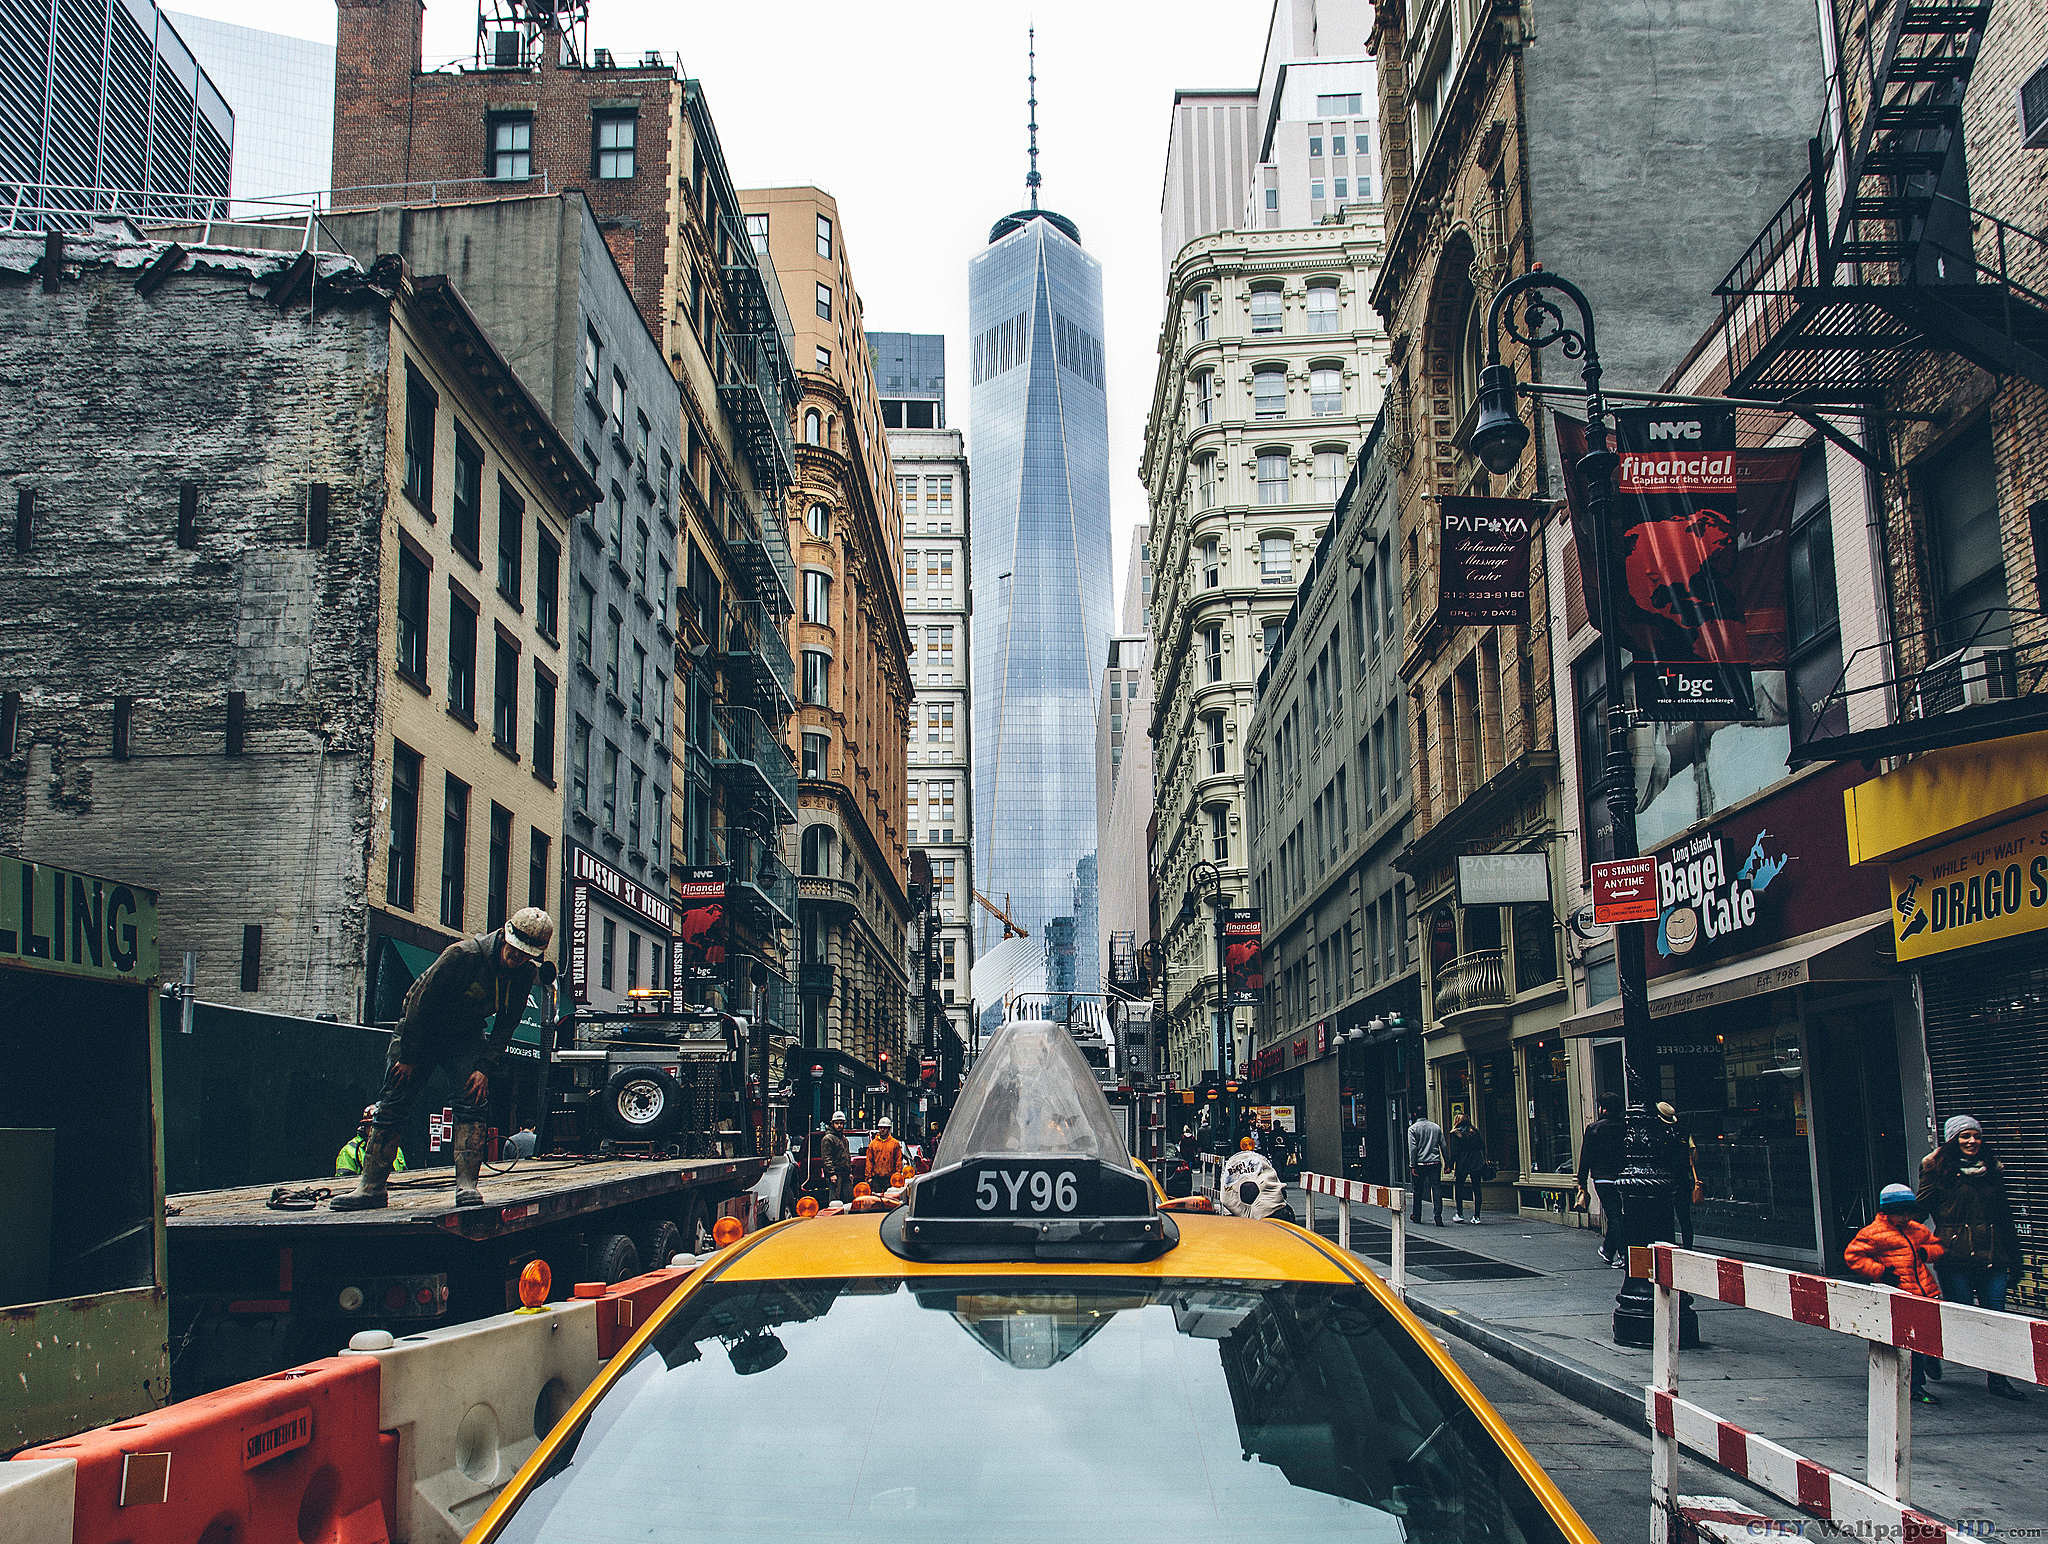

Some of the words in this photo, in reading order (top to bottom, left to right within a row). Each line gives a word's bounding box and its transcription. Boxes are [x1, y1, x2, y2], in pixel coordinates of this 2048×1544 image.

[1649, 421, 1702, 440] NYC
[1621, 456, 1732, 481] financial
[1632, 475, 1667, 486] Capital
[1669, 475, 1681, 485] of
[1683, 475, 1699, 485] the
[1701, 475, 1733, 485] World
[1460, 554, 1509, 569] Massage
[1465, 569, 1502, 581] Center
[1491, 609, 1517, 617] DAYS
[1678, 673, 1713, 697] bgc
[1671, 847, 1690, 863] Long
[1689, 831, 1713, 857] Island
[1932, 856, 1968, 881] WHILE
[1993, 837, 2026, 861] WAIT
[693, 870, 714, 878] NYC
[1597, 868, 1608, 878] NO
[1611, 863, 1650, 876] STANDING
[1659, 838, 1726, 908] Bagel
[582, 854, 620, 896] NASSAU
[641, 893, 671, 927] DENTAL
[682, 882, 725, 895] financial
[1604, 876, 1645, 889] ANYTIME
[574, 886, 587, 930] NASSAU
[1702, 879, 1756, 939] Cafe
[1930, 863, 2022, 934] DRAGO
[1226, 922, 1260, 932] financial
[573, 947, 585, 985] DENTAL
[673, 941, 683, 976] NASSAU
[697, 967, 711, 976] bgc
[1776, 965, 1801, 983] 1986
[975, 1170, 1078, 1212] 5Y96
